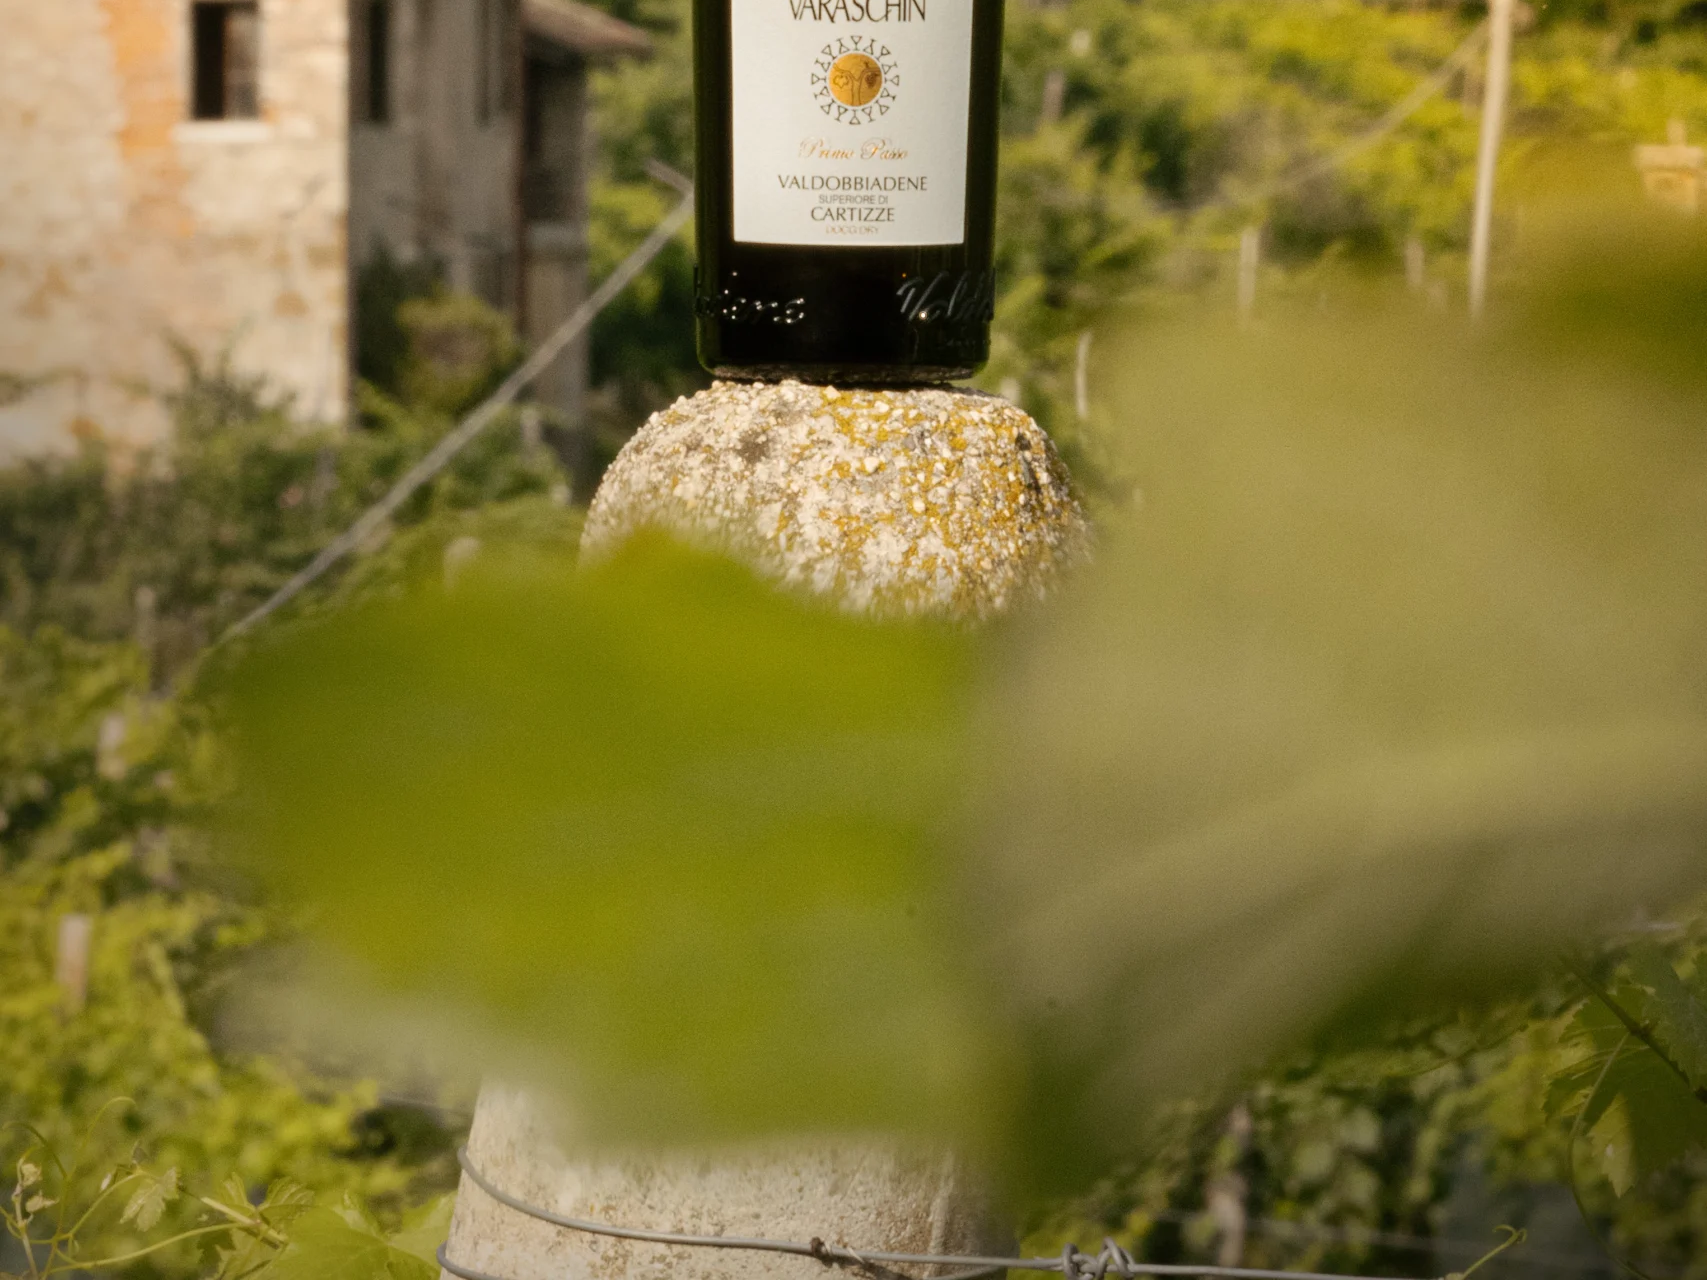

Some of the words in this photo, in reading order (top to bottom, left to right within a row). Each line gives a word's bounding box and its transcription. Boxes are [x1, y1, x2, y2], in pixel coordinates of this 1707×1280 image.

[778, 174, 928, 191] VALDOBBIADENE
[818, 194, 876, 205] SUPERIORE
[878, 195, 889, 205] DI
[811, 206, 895, 222] CARTIZZE
